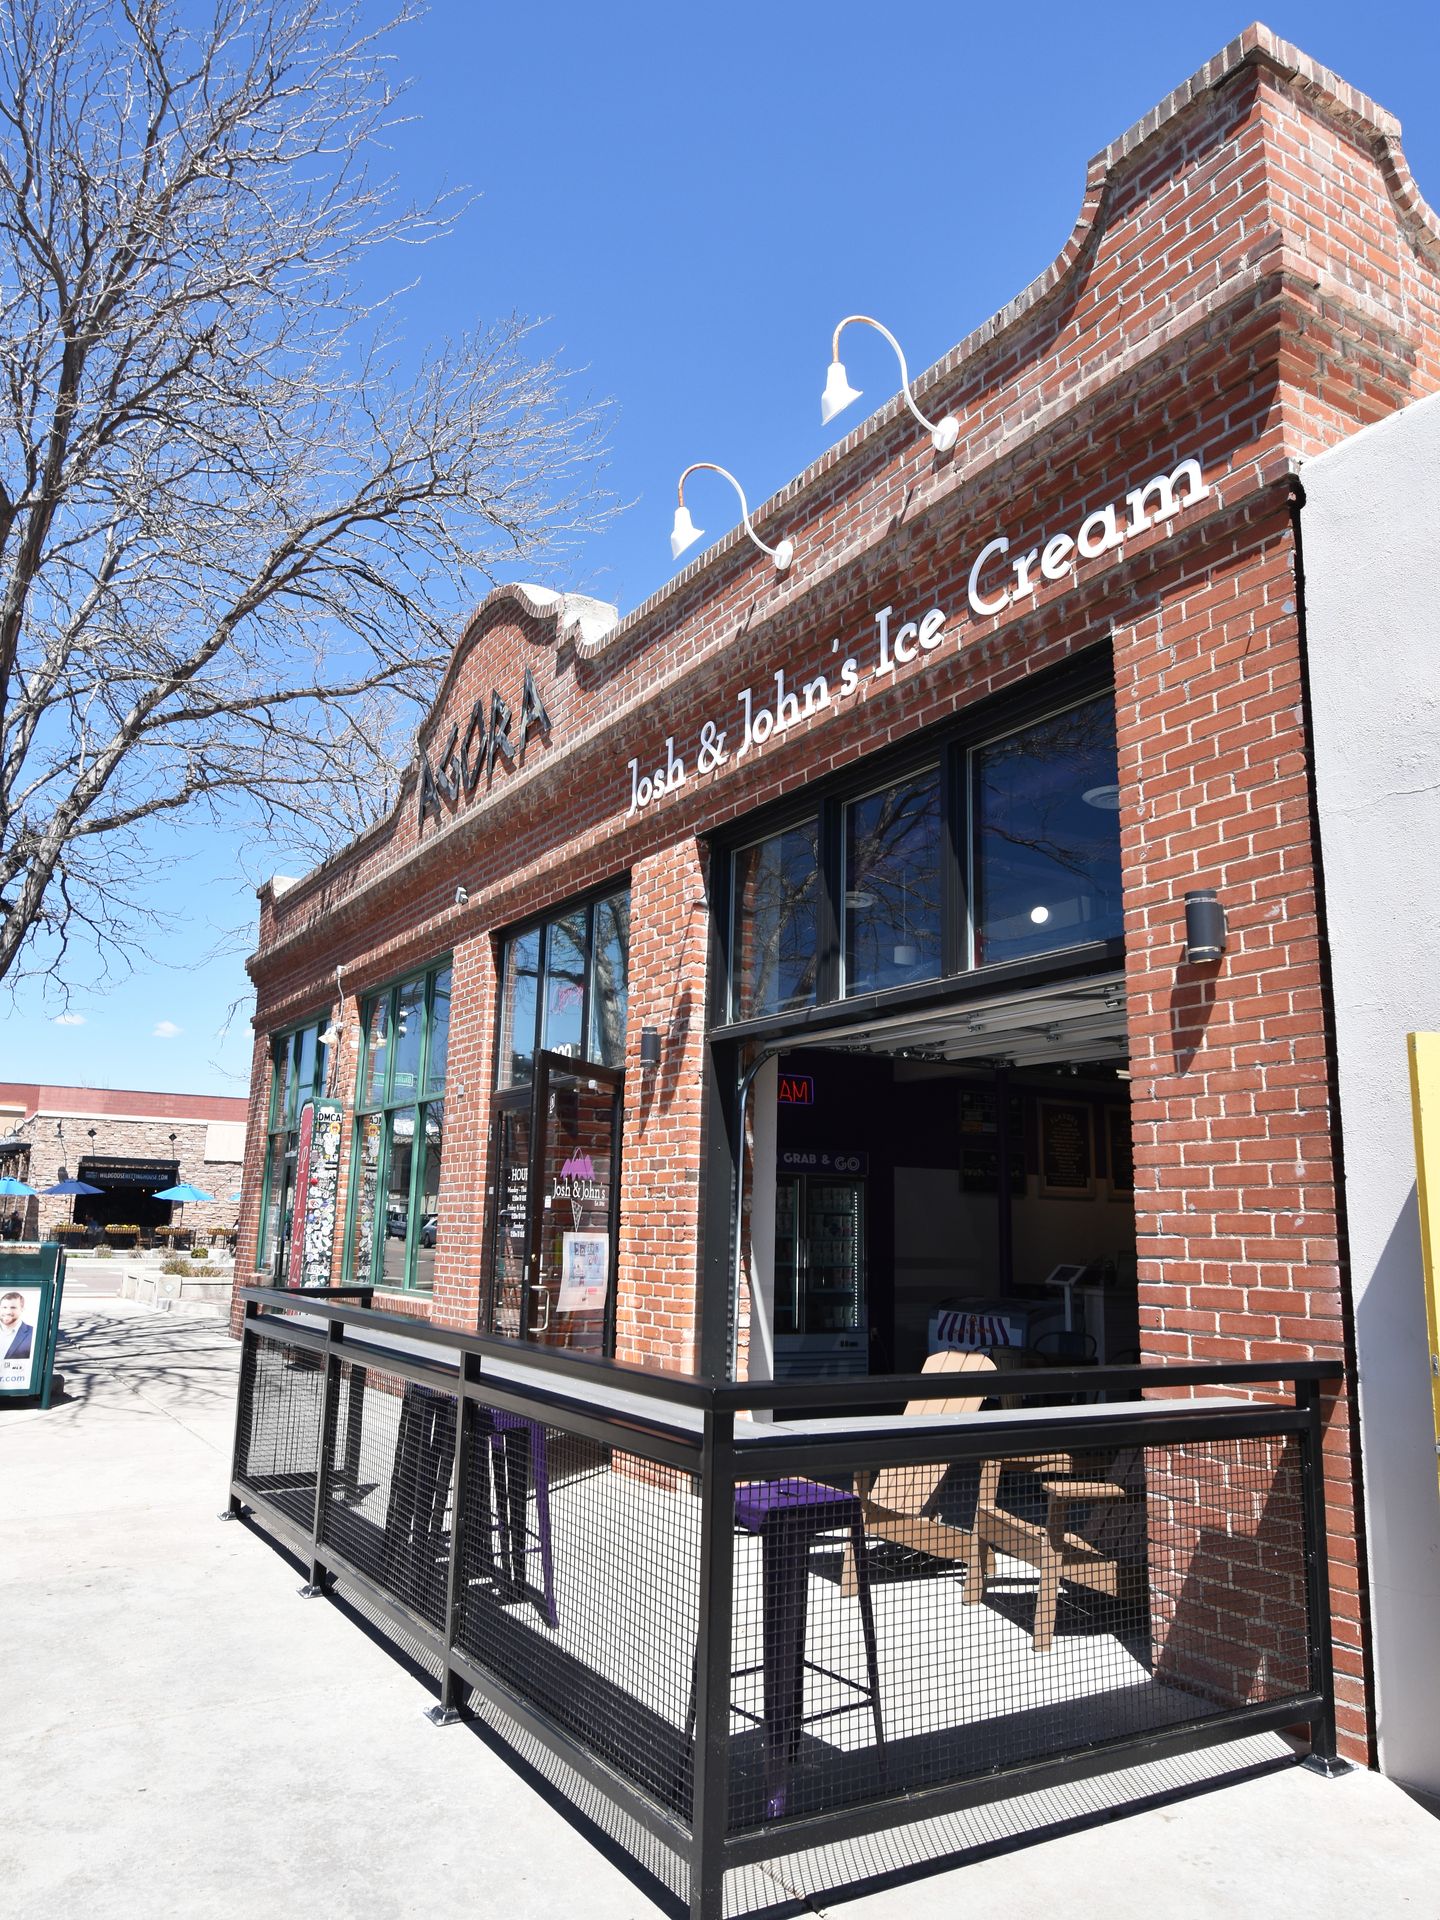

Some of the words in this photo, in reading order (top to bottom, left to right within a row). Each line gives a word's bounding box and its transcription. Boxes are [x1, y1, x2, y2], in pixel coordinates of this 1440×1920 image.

[626, 736, 686, 818] Josh
[697, 720, 729, 774] &
[737, 638, 859, 758] John's
[874, 605, 947, 678] Ice
[967, 458, 1210, 616] Cream
[418, 663, 552, 827] AGORA
[318, 1113, 341, 1122] DMCA
[783, 1152, 817, 1165] GRAB
[821, 1154, 831, 1165] &
[834, 1156, 860, 1171] GO
[552, 1177, 571, 1199] Josh
[572, 1180, 581, 1198] &
[581, 1179, 606, 1201] John's
